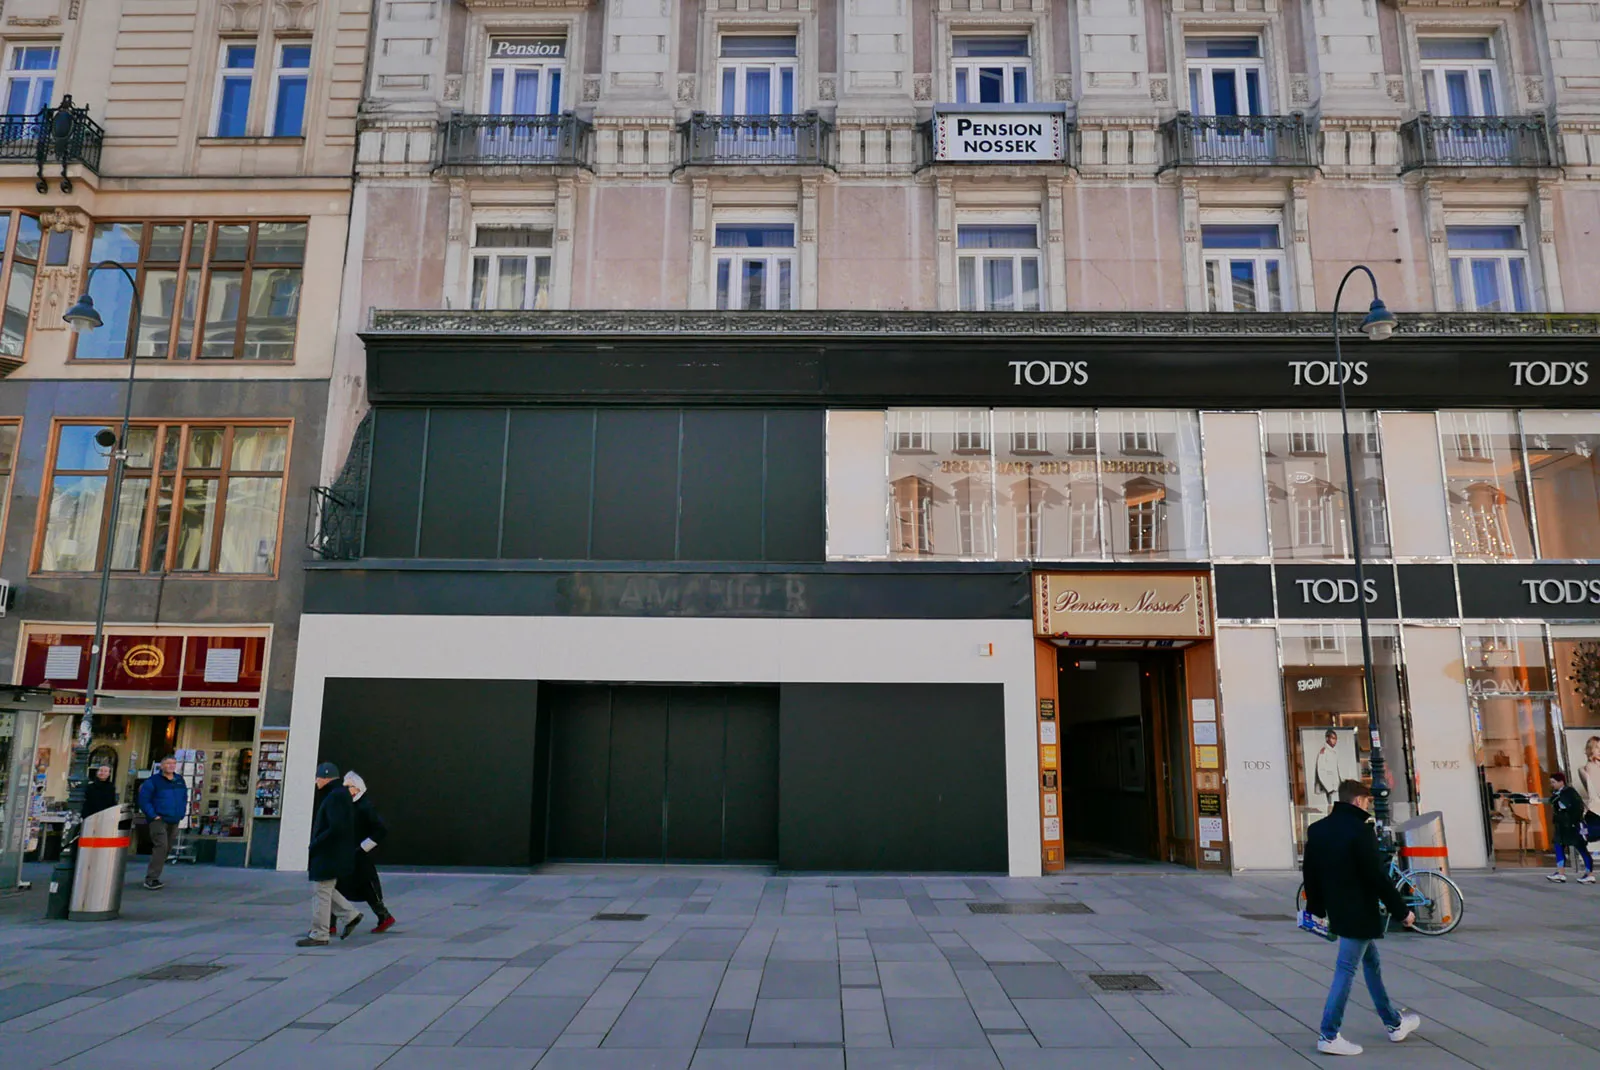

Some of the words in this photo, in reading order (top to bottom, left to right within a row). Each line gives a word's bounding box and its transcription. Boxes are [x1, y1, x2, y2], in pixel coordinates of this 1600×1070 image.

[495, 42, 561, 56] Pension
[964, 140, 1038, 153] NOSSEK
[1008, 360, 1089, 386] TOD'S
[1287, 360, 1369, 386] TOD'S
[1508, 360, 1589, 386] TOD'S
[1053, 590, 1121, 614] Pension
[1124, 588, 1192, 615] Nossek
[1295, 578, 1378, 604] TODS
[1521, 578, 1600, 604] TOD'S
[55, 695, 80, 705] SSIK
[190, 698, 250, 708] SPEZIALHAUS
[1243, 760, 1271, 770] TOD'S
